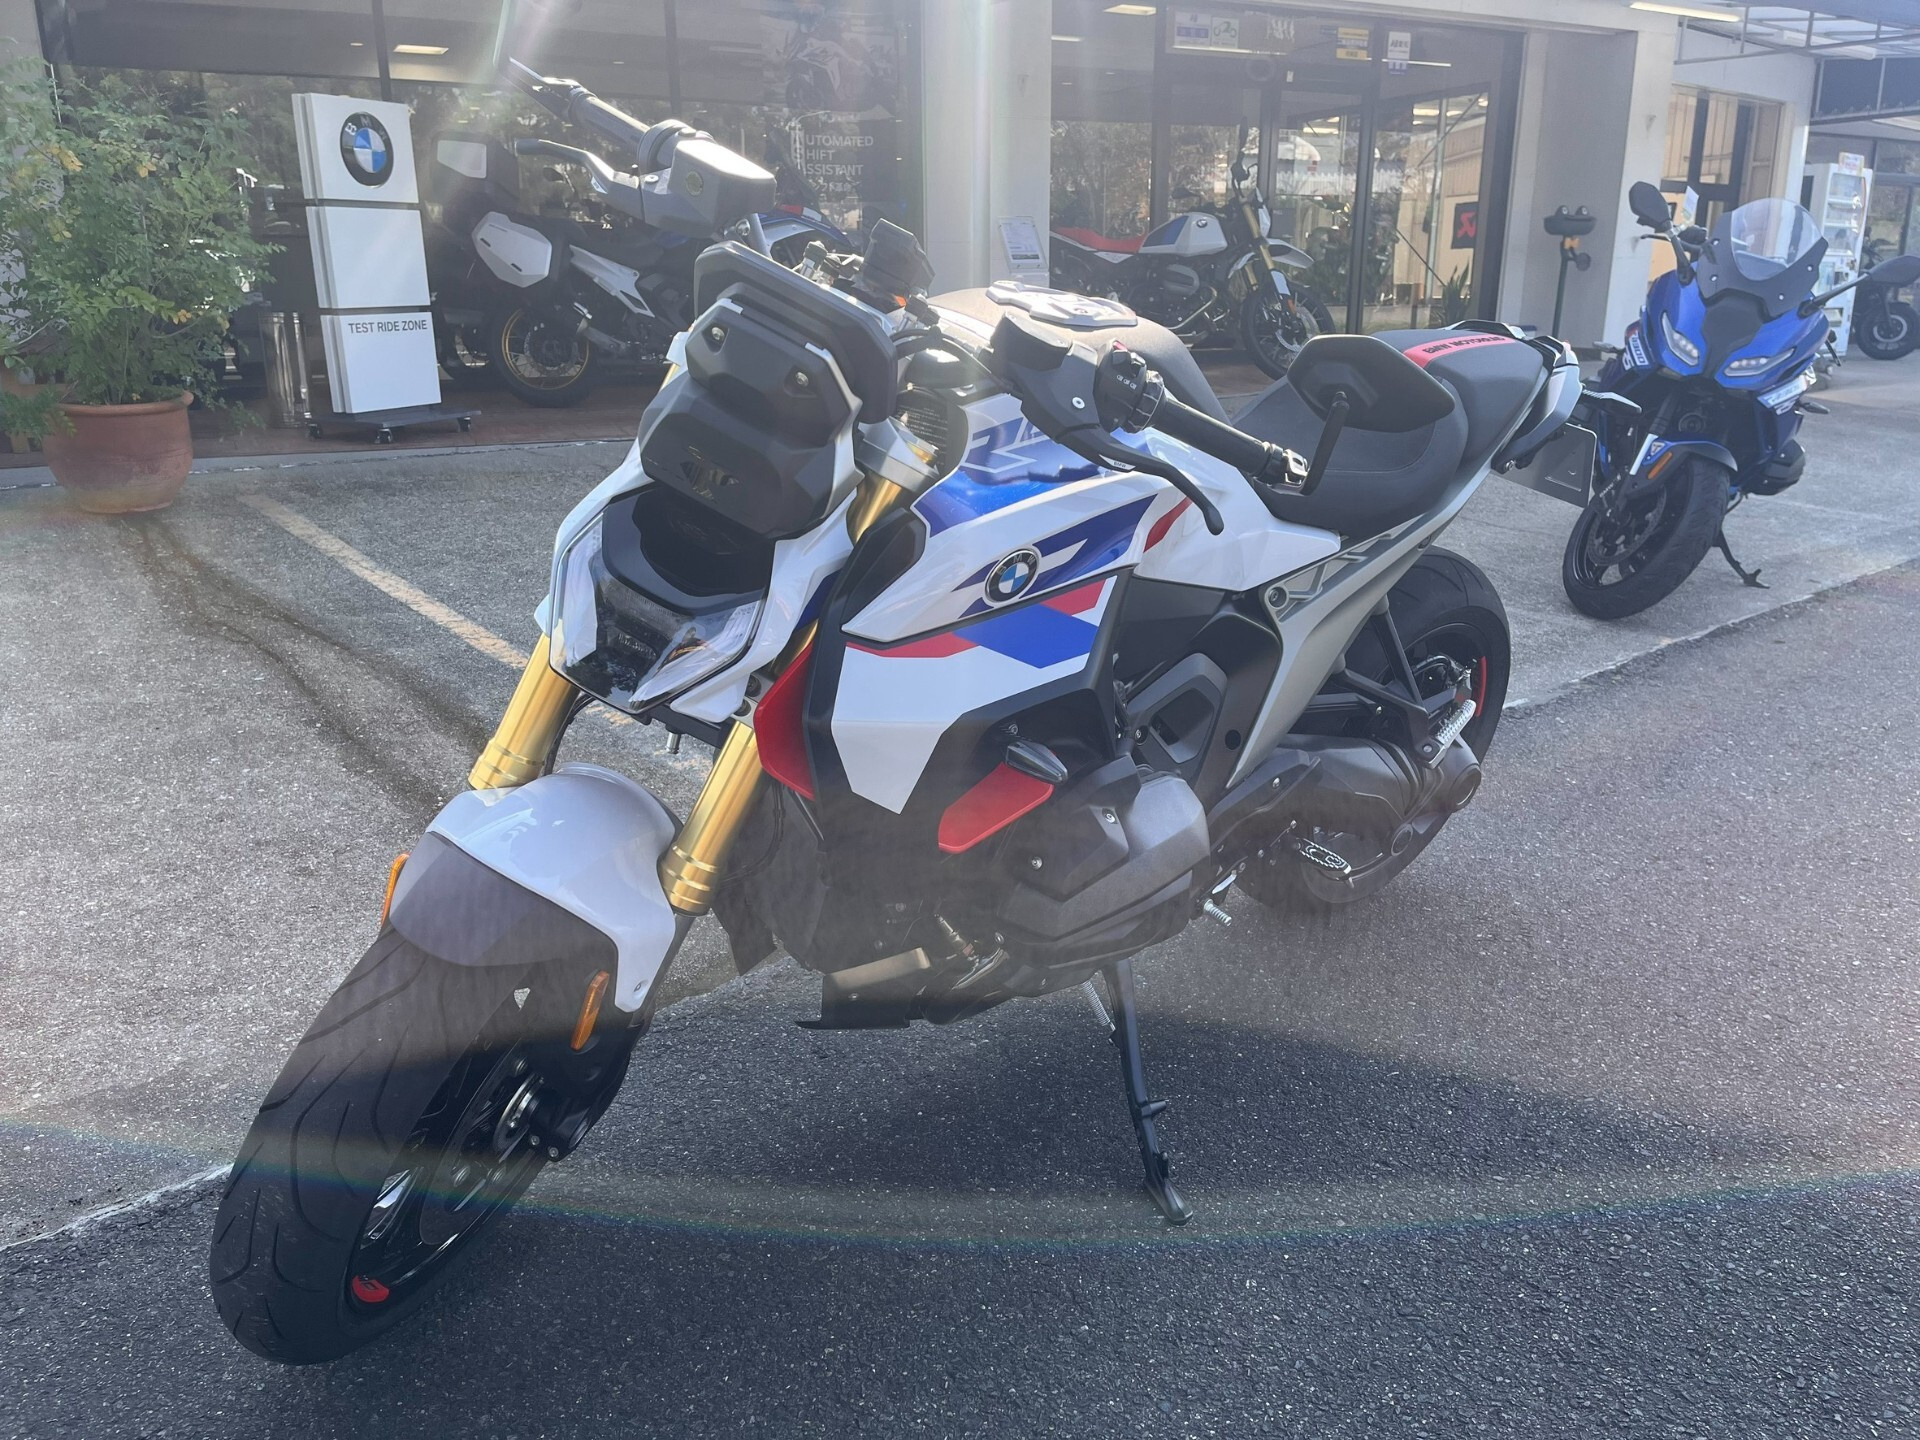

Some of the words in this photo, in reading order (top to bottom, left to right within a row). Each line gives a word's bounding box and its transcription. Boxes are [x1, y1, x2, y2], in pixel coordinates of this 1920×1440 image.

[348, 322, 374, 334] TEST
[377, 321, 400, 332] RIDE
[402, 319, 427, 331] ZONE
